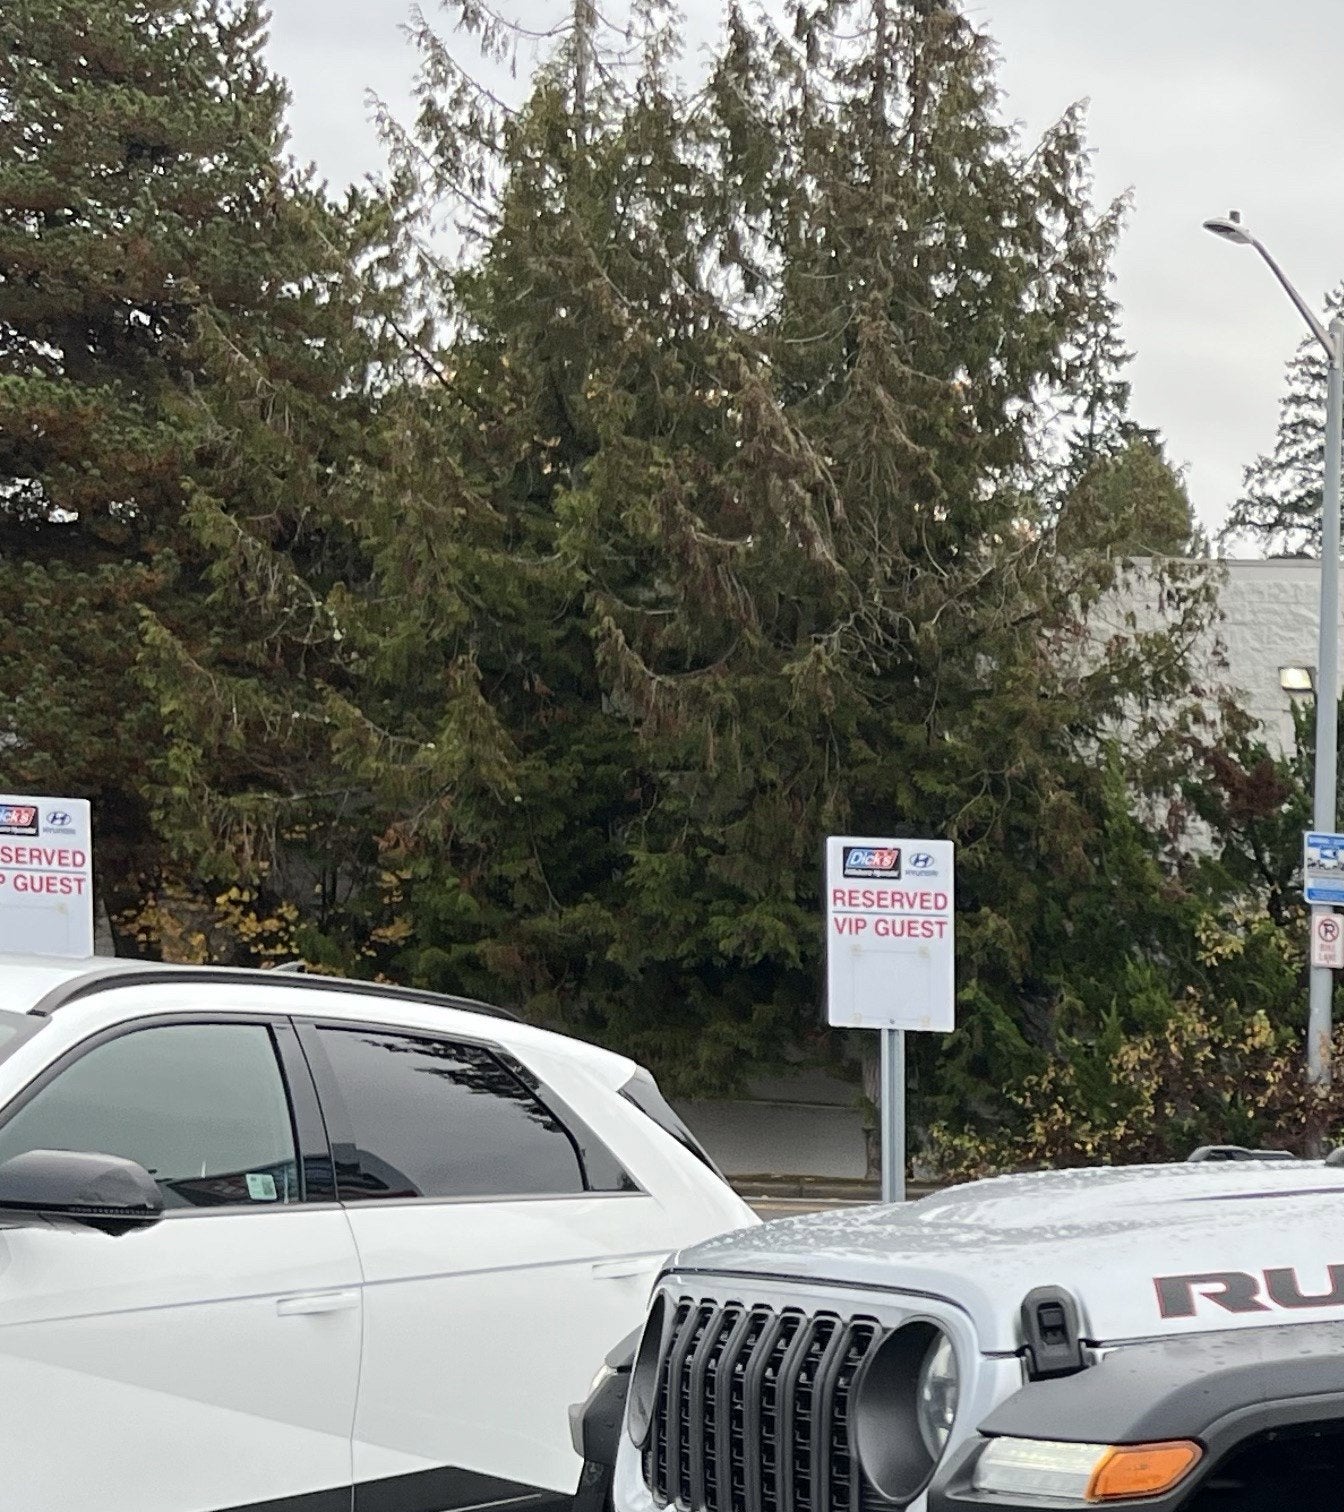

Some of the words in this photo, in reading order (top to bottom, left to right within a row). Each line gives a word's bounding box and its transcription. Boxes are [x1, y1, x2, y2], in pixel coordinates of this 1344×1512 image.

[13, 874, 86, 895] GUEST
[833, 889, 948, 910] RESERVED
[834, 918, 867, 935] VIP
[875, 919, 948, 938] GUEST
